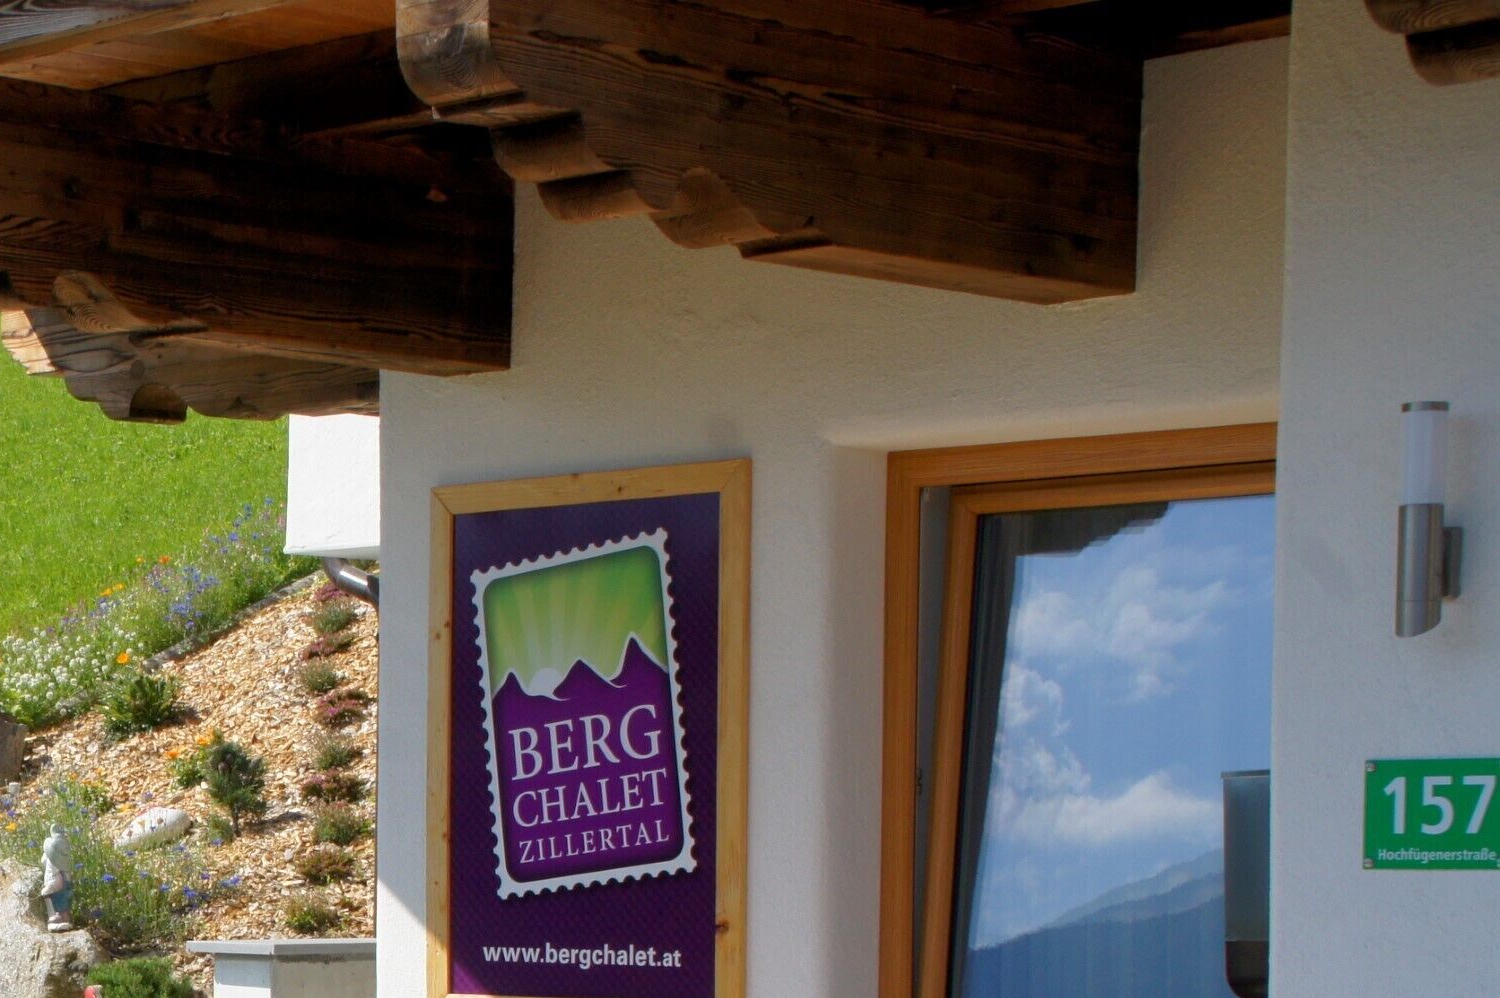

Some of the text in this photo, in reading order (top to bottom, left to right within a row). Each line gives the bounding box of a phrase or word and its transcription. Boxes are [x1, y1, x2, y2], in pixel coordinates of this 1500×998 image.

[508, 704, 661, 781] BERG
[512, 768, 667, 827] CHALET
[1383, 775, 1497, 835] 157
[519, 820, 670, 864] ZILLERTAL
[1378, 848, 1497, 864] Hochfügenerstraße
[482, 942, 682, 970] www.bergchalet.at
